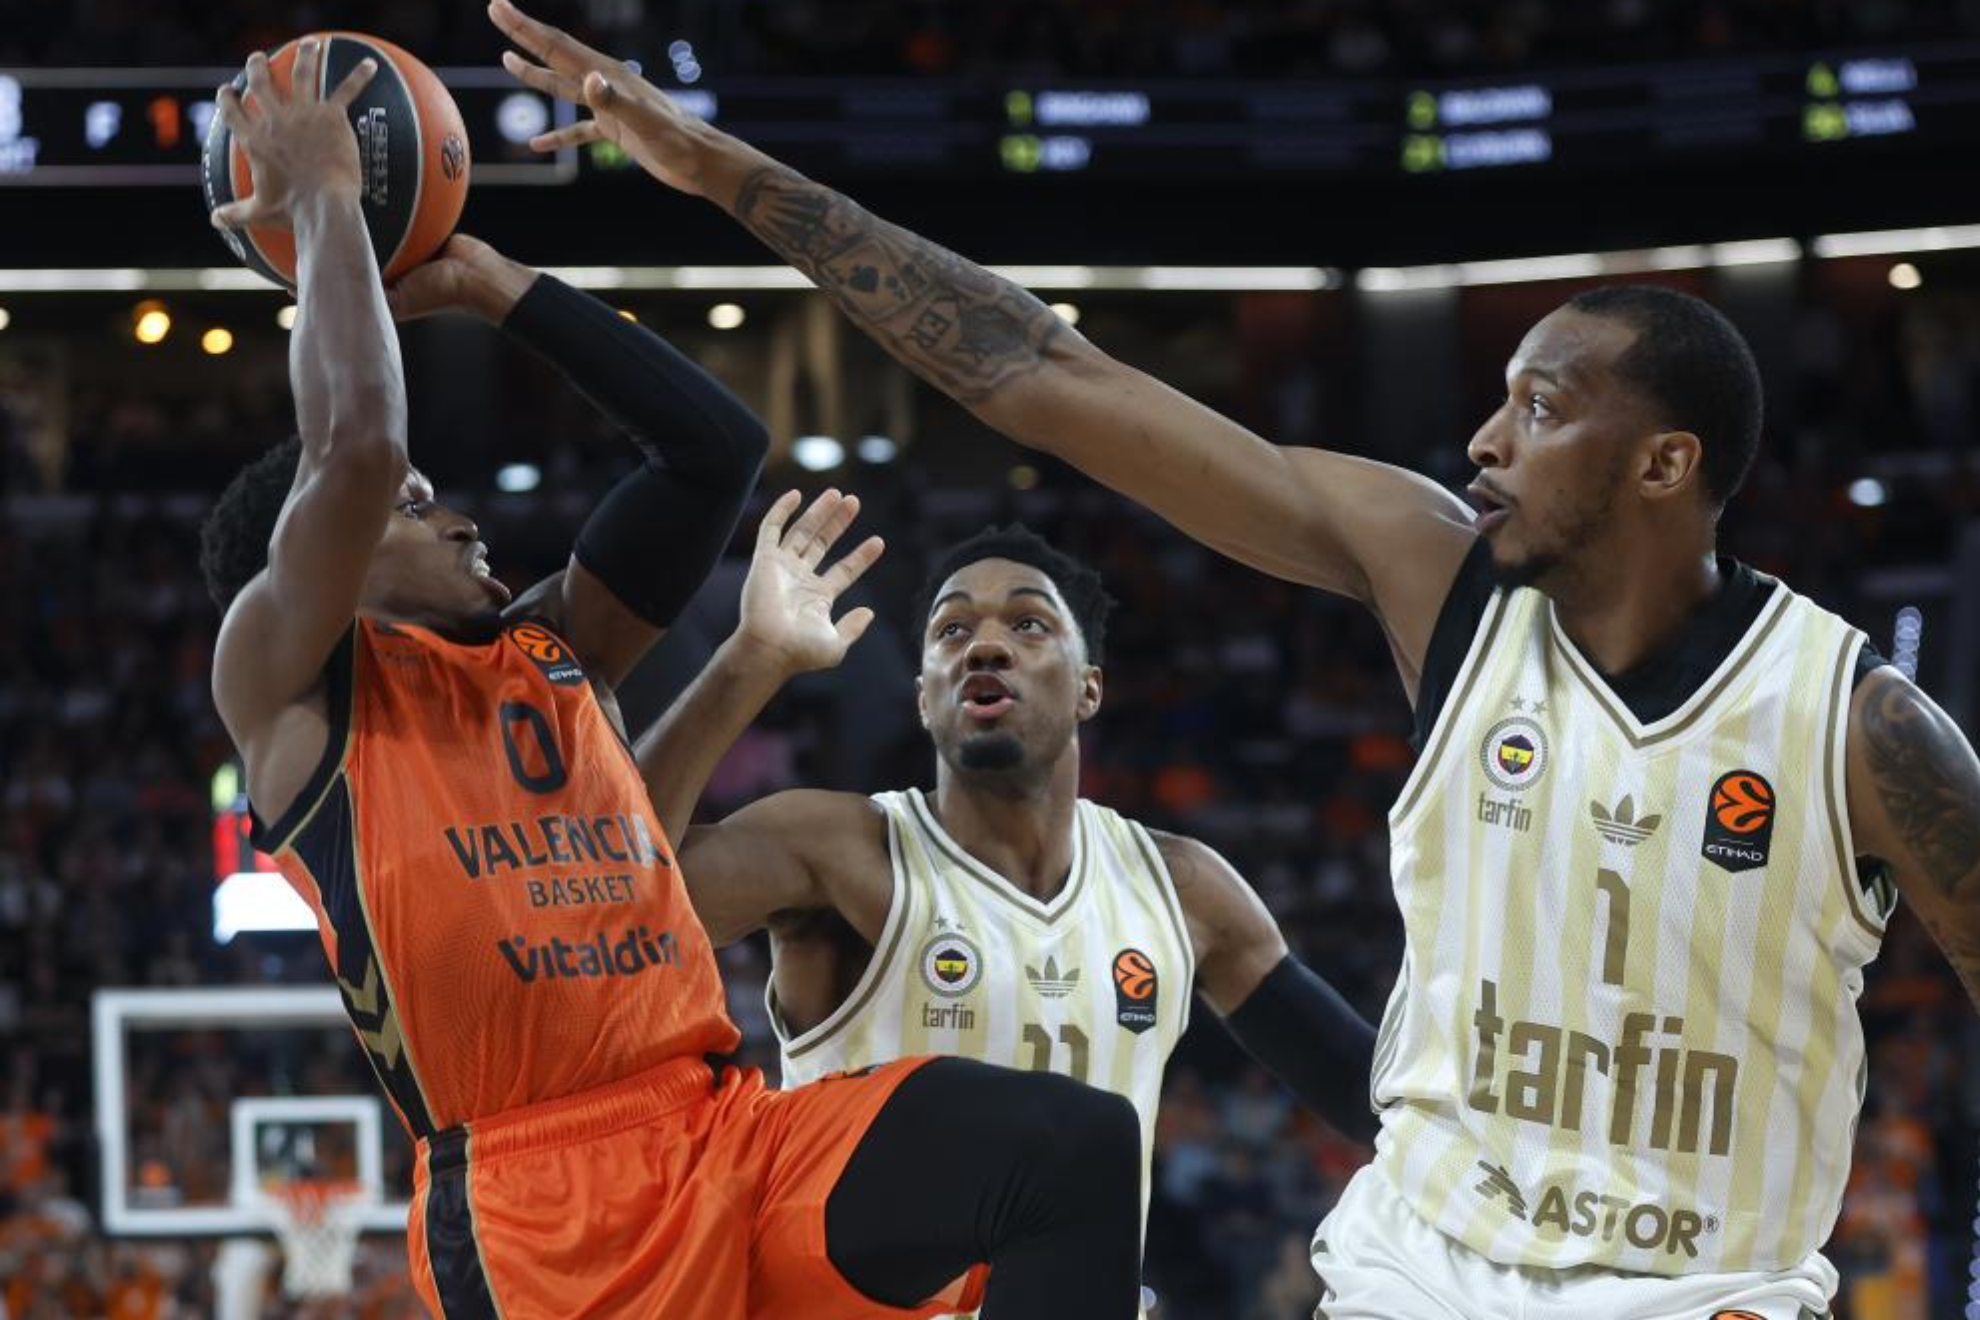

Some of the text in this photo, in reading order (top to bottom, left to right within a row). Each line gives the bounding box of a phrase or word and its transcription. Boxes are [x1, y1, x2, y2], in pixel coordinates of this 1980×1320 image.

[501, 701, 568, 795] 0
[1478, 792, 1532, 832] tarfin
[444, 813, 671, 879] VALENCIA
[1705, 844, 1764, 862] ETIHAD
[527, 874, 638, 908] BASKET
[497, 925, 682, 984] Vitaldin
[1596, 867, 1631, 986] 1
[922, 1002, 975, 1030] tarfin
[1468, 978, 1739, 1157] tarfin
